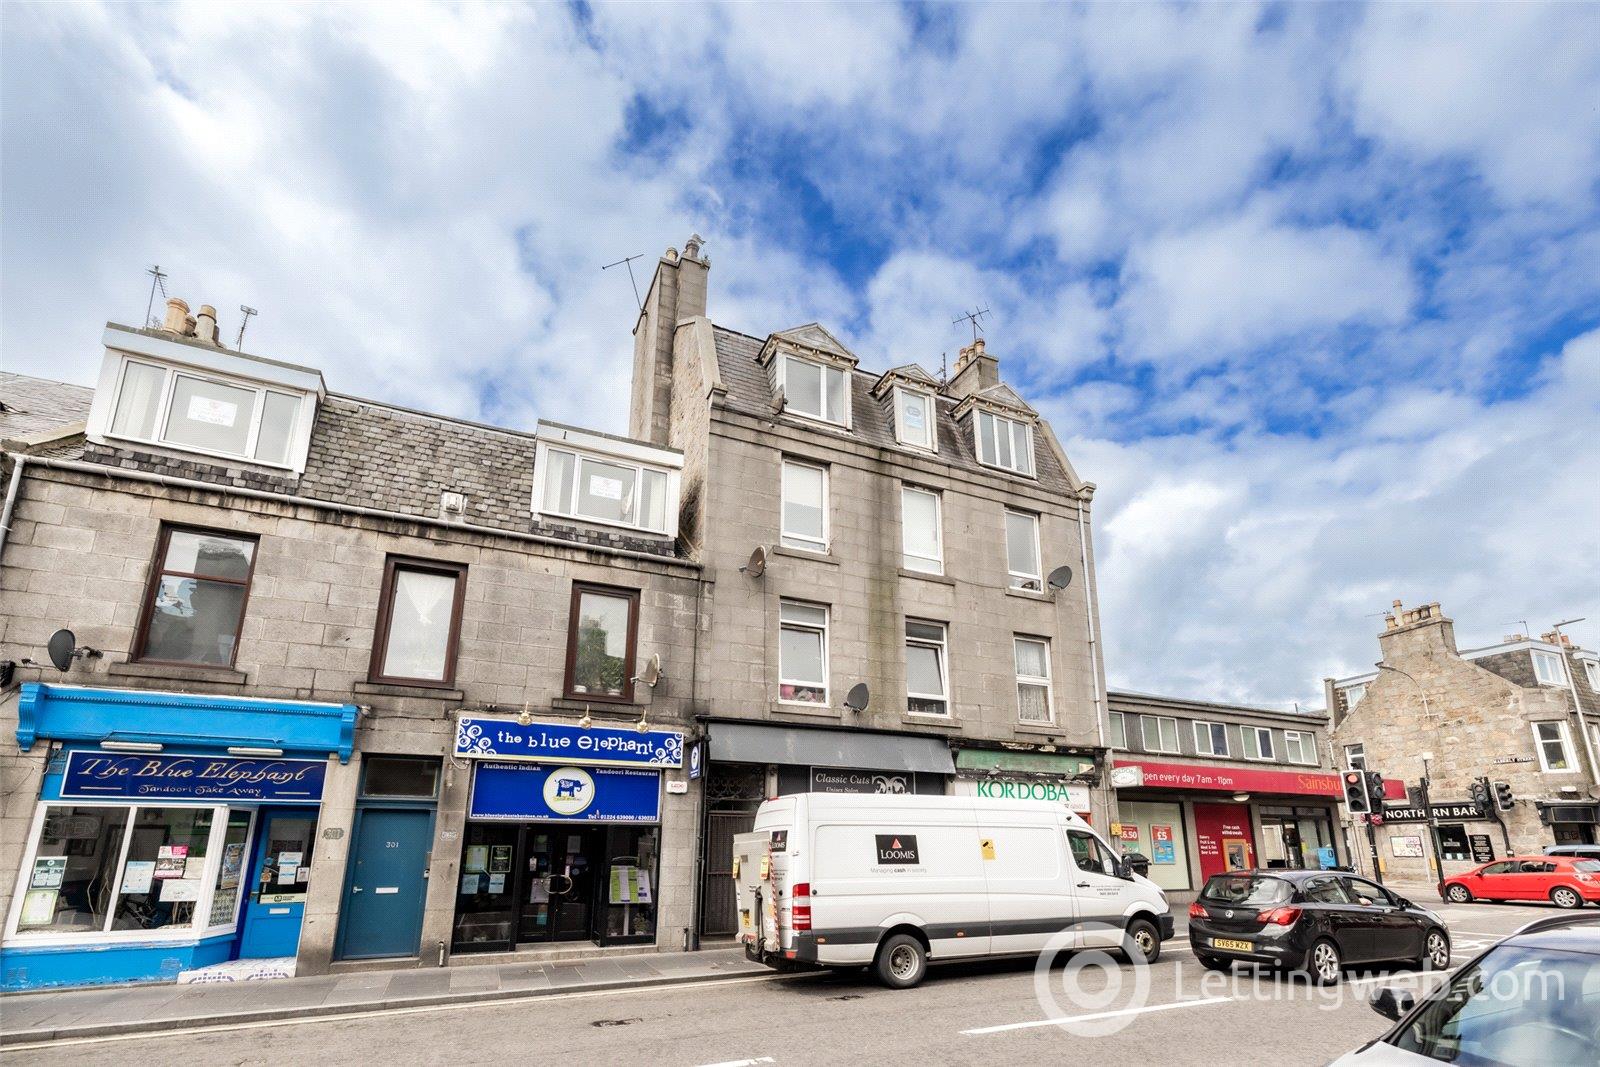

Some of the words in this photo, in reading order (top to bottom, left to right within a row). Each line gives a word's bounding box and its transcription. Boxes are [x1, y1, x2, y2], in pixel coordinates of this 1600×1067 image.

[498, 731, 522, 744] the
[528, 733, 571, 749] blue
[78, 757, 140, 780] The
[133, 759, 195, 778] Blue
[196, 761, 319, 787] Elephant
[483, 763, 517, 771] Authentic
[519, 764, 541, 772] Indian
[595, 768, 624, 776] Tandoori
[625, 769, 659, 777] Restaurant
[816, 773, 848, 784] Classic
[850, 774, 870, 785] Cuts
[1144, 772, 1158, 782] pen
[1159, 773, 1180, 783] every
[1182, 773, 1195, 784] day
[1297, 774, 1341, 792] Sainsbu
[139, 784, 192, 794] Tandoori
[195, 785, 224, 795] Take
[226, 787, 262, 797] Away
[977, 779, 1069, 801] KORDOBA
[1385, 807, 1450, 819] NORTHRN
[1453, 806, 1478, 817] BAR
[1157, 831, 1168, 841] £5
[385, 841, 400, 849] 301
[880, 849, 916, 860] LOOMIS
